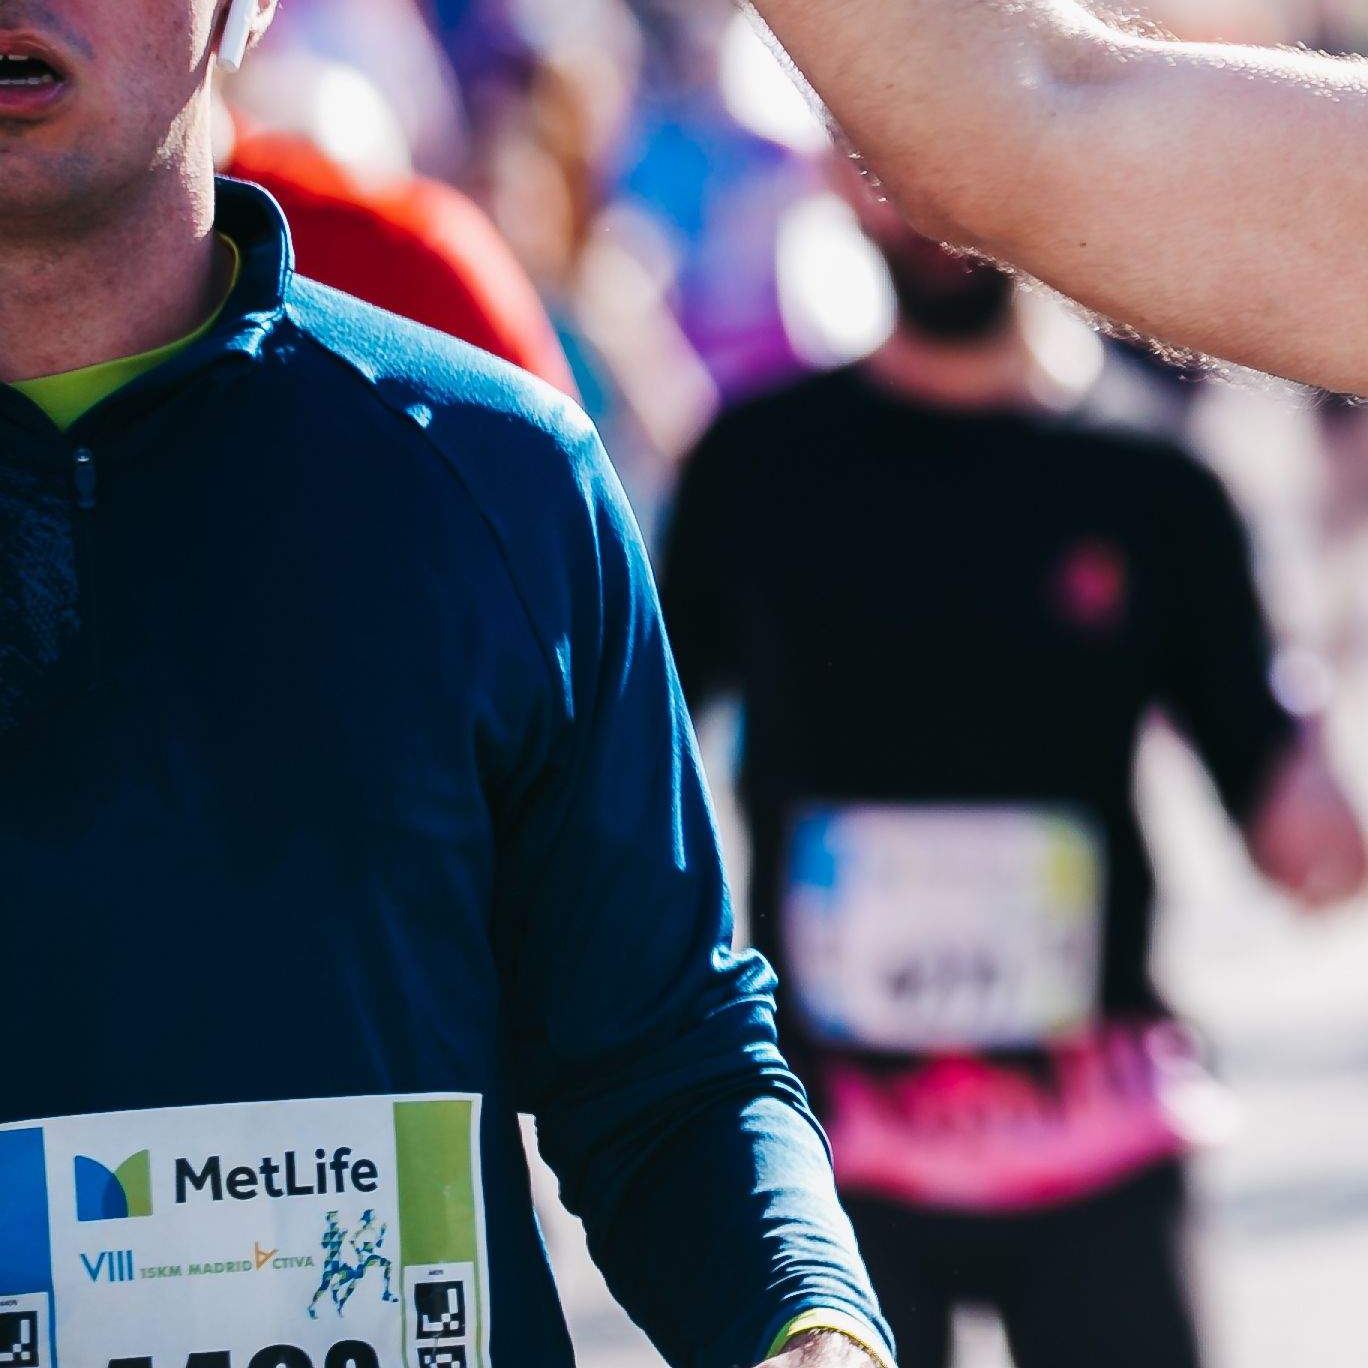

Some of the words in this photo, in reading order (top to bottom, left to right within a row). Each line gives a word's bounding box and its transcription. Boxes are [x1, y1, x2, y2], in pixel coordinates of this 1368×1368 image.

[174, 1146, 379, 1205] MetLife
[79, 1248, 135, 1284] VIII
[187, 1258, 252, 1277] MADRID
